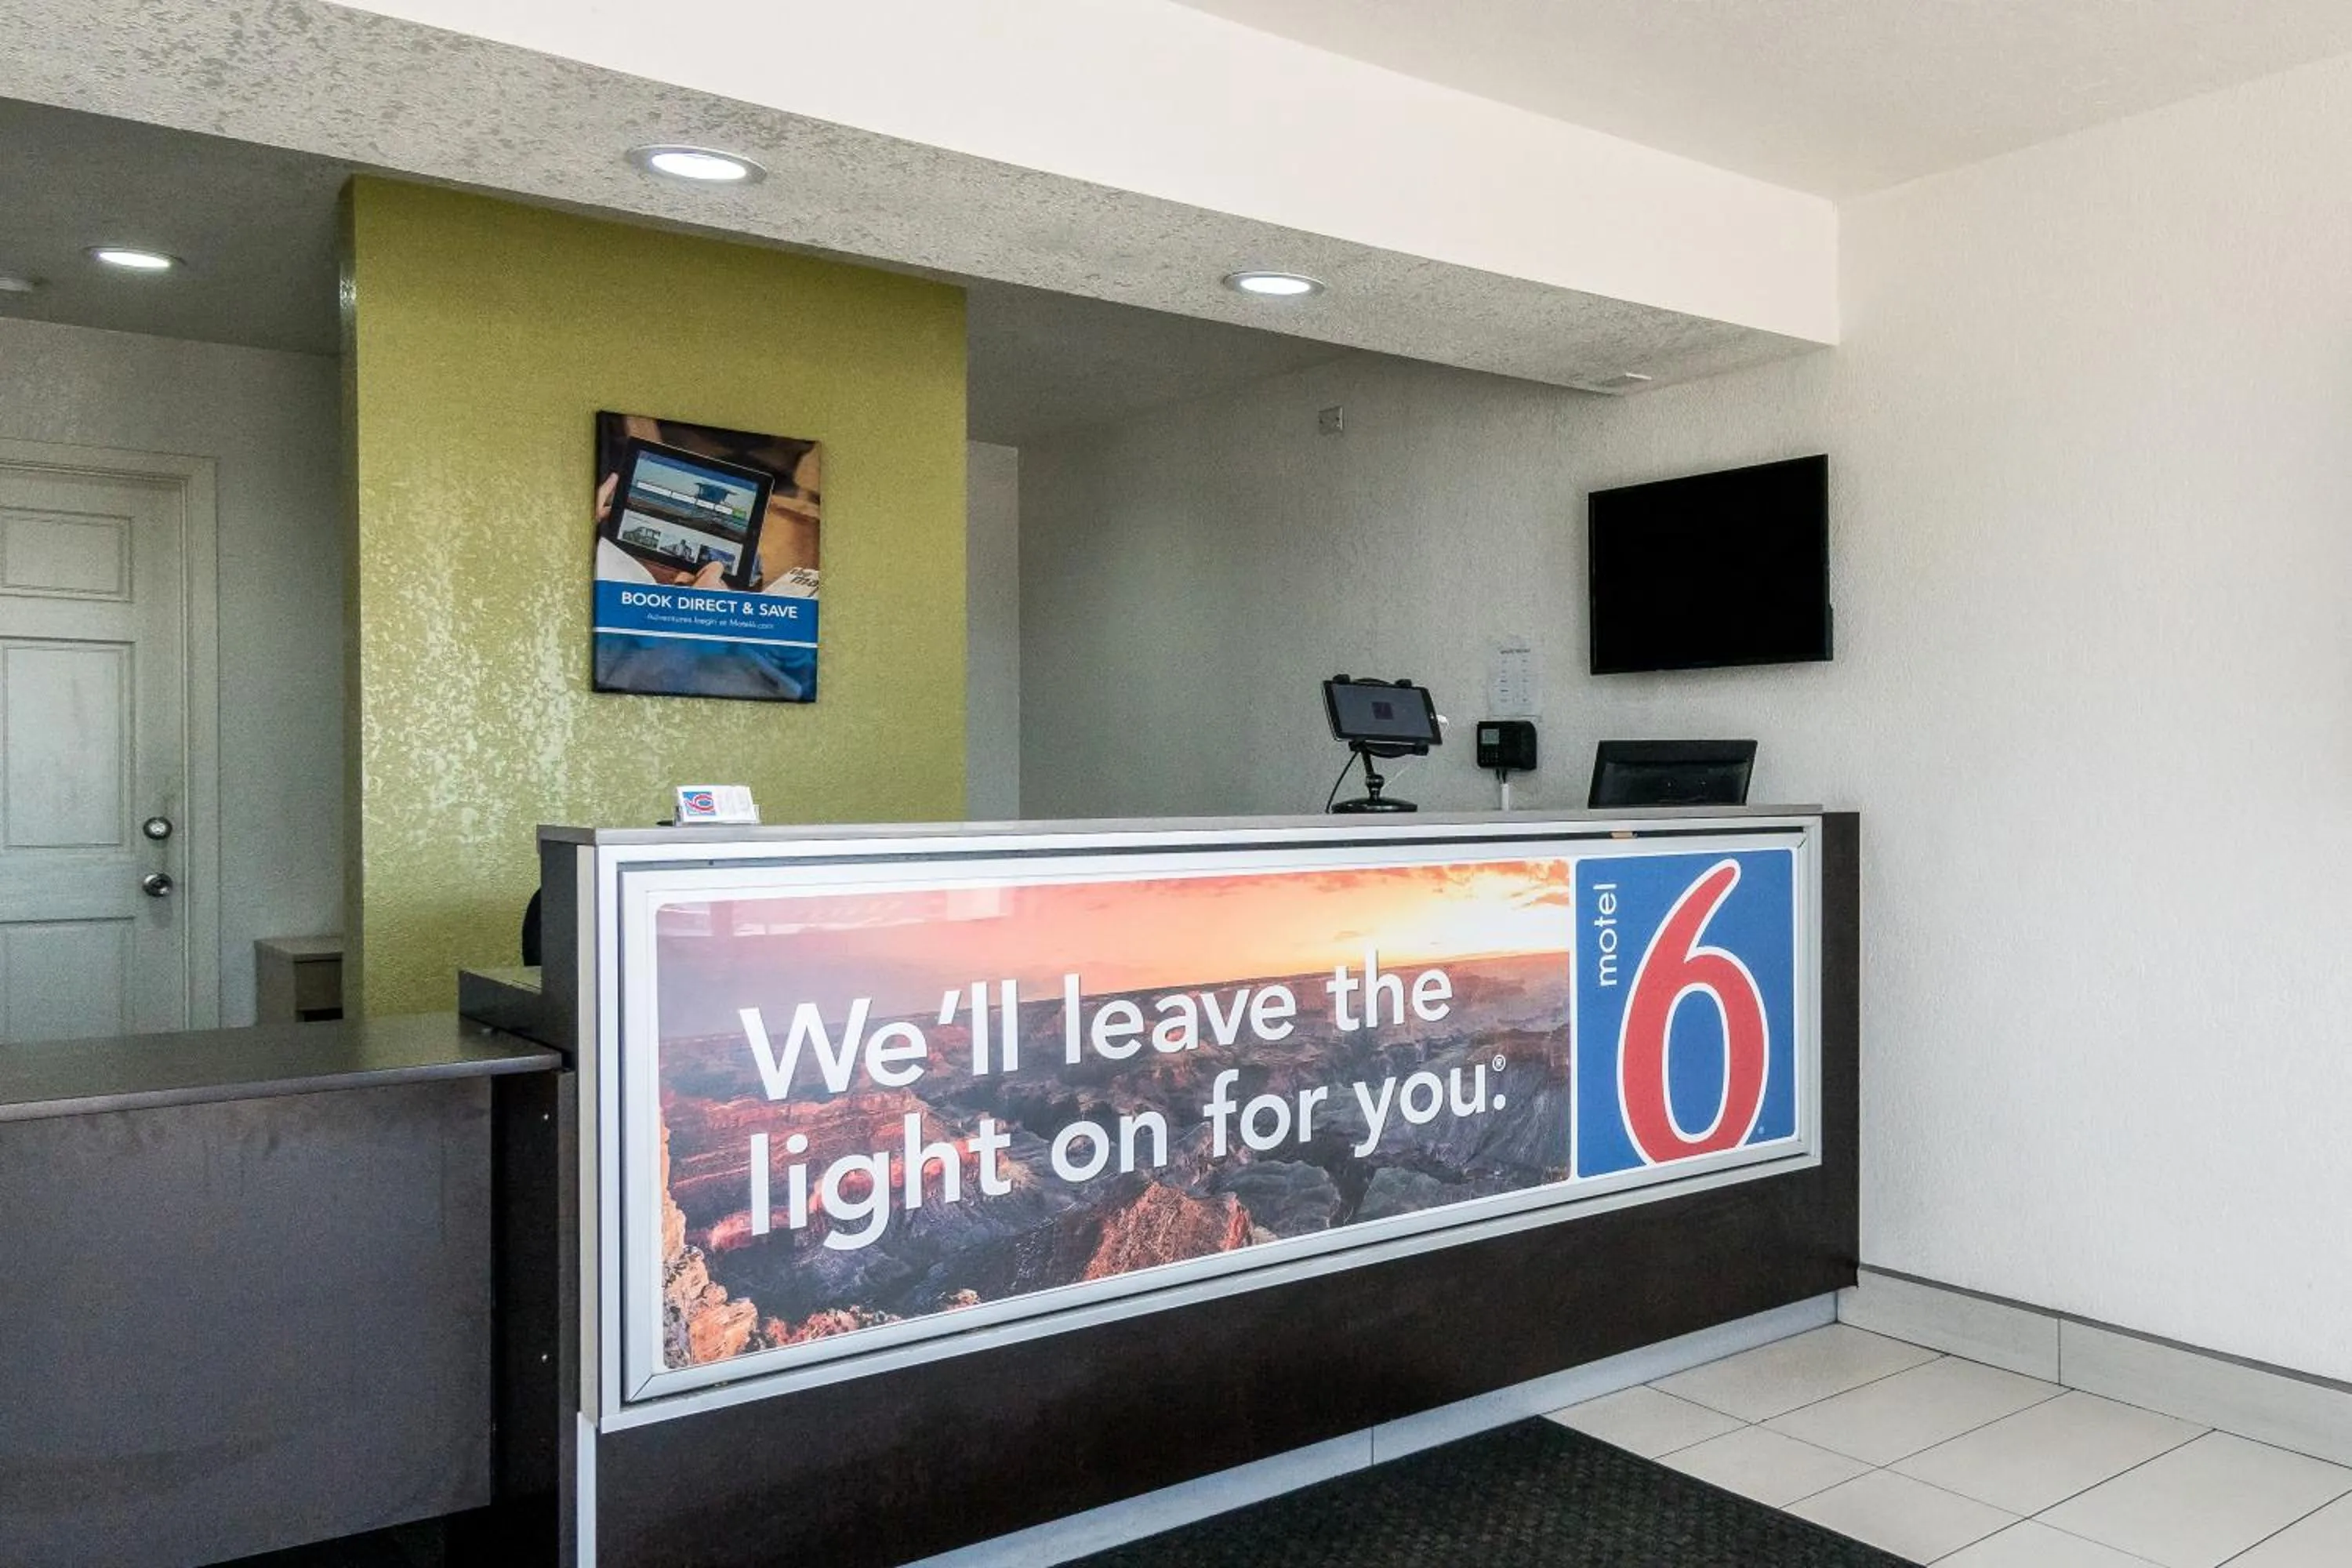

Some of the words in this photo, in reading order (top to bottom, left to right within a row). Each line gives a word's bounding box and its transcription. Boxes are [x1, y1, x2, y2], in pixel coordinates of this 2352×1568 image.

[622, 590, 672, 608] BOOK
[678, 597, 738, 613] DIRECT
[742, 601, 753, 615] &
[759, 603, 799, 619] SAVE
[1593, 883, 1617, 987] motel
[1616, 858, 1770, 1164] 6
[739, 978, 1019, 1101] We'll
[1064, 973, 1297, 1065] leave
[1326, 947, 1454, 1033] the
[750, 1112, 1012, 1251] light
[1051, 1110, 1168, 1182] on
[1203, 1069, 1327, 1159] for
